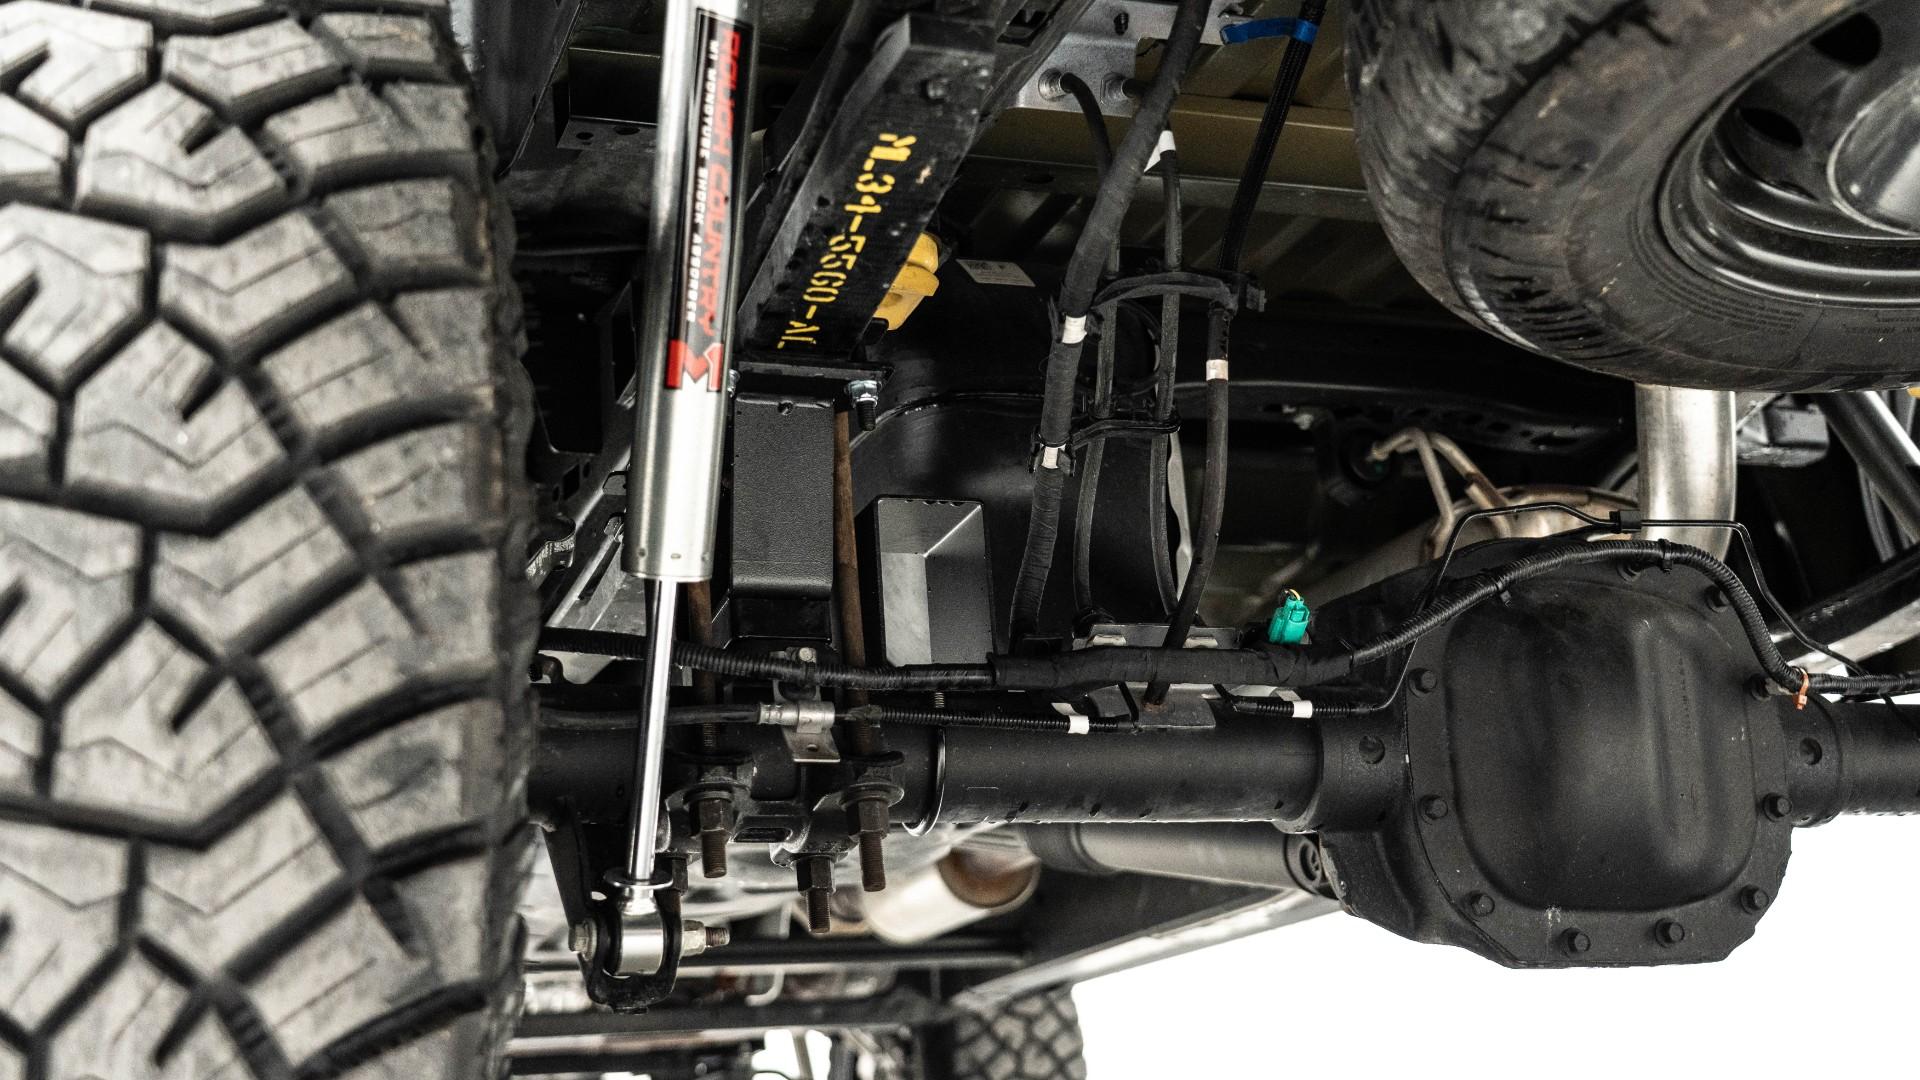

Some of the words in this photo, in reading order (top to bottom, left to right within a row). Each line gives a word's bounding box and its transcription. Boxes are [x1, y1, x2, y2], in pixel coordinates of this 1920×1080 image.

[700, 68, 717, 159] MONOTUBE
[712, 29, 741, 156] ROUGH
[694, 168, 708, 224] SHOCK
[687, 232, 703, 323] ABSORBER
[698, 164, 729, 336] COUNTRY
